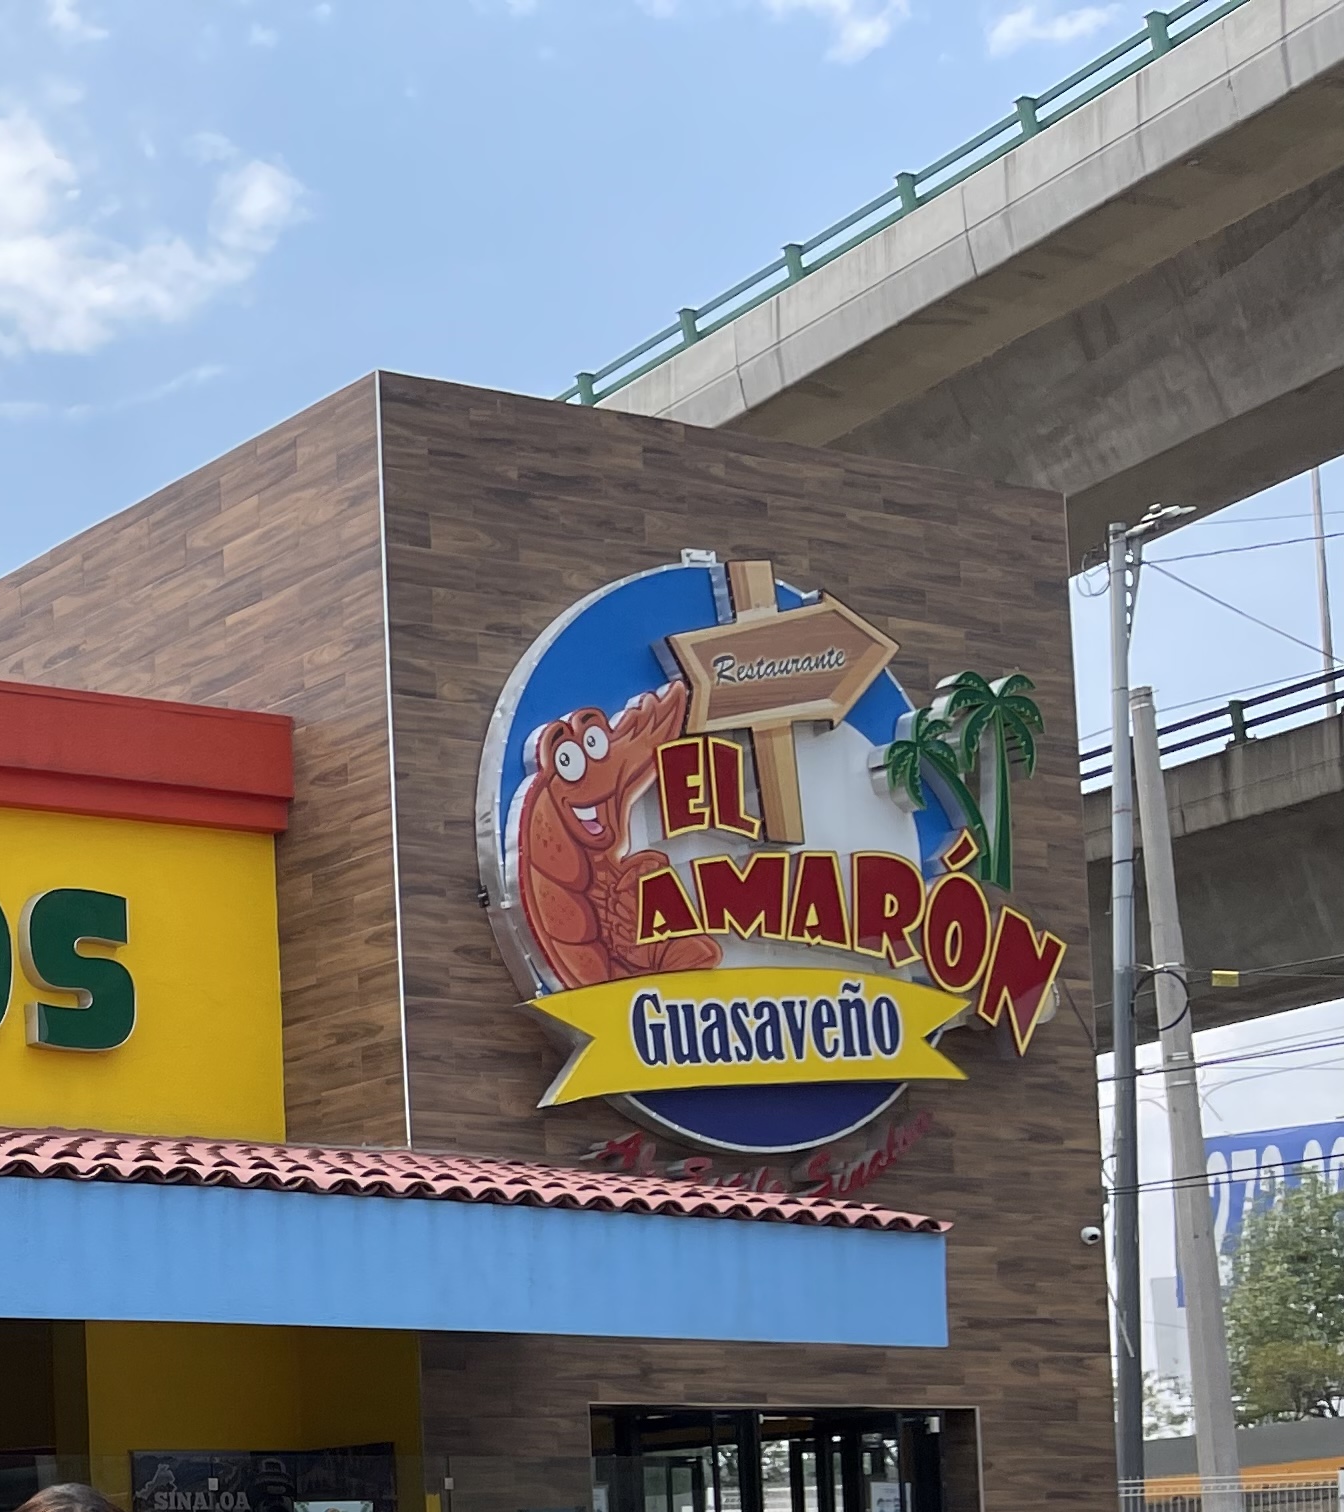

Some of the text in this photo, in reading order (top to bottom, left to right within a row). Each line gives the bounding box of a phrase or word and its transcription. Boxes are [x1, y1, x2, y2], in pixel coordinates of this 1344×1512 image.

[712, 646, 846, 688] Restaurante
[653, 735, 761, 841] EL
[636, 830, 1066, 1056] AMARÓN
[631, 983, 901, 1067] Guasaveño
[154, 1491, 251, 1511] SINALOA
